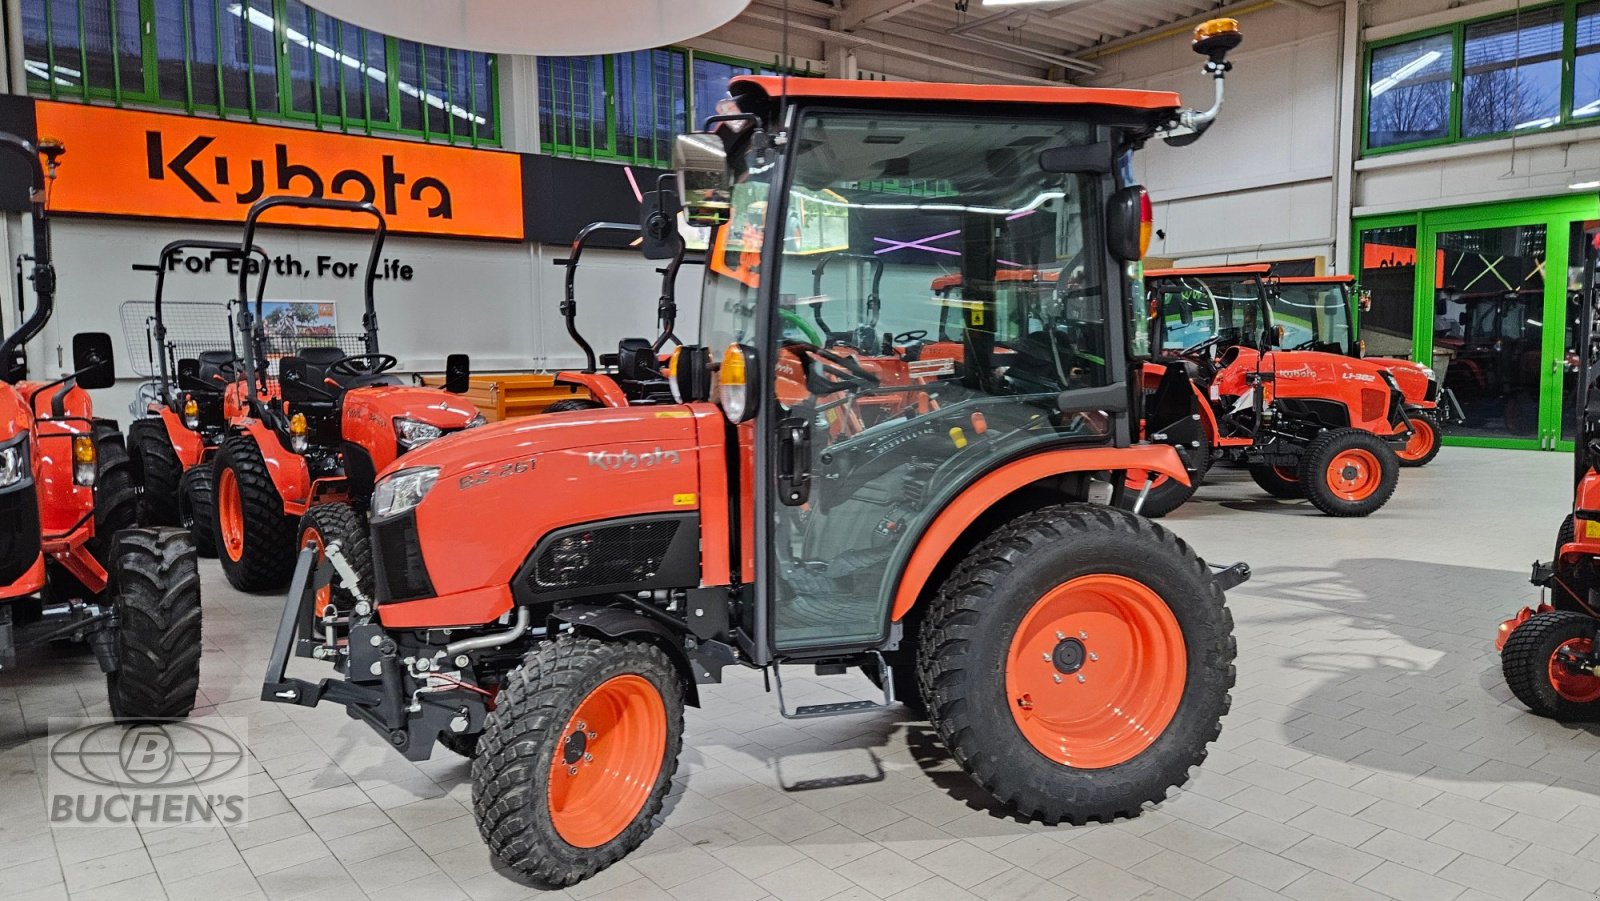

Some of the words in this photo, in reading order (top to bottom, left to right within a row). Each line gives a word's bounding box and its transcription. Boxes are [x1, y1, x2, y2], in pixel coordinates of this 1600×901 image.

[145, 130, 453, 219] Kubota
[168, 250, 212, 273] For
[317, 254, 358, 278] For
[587, 447, 680, 470] Kubota
